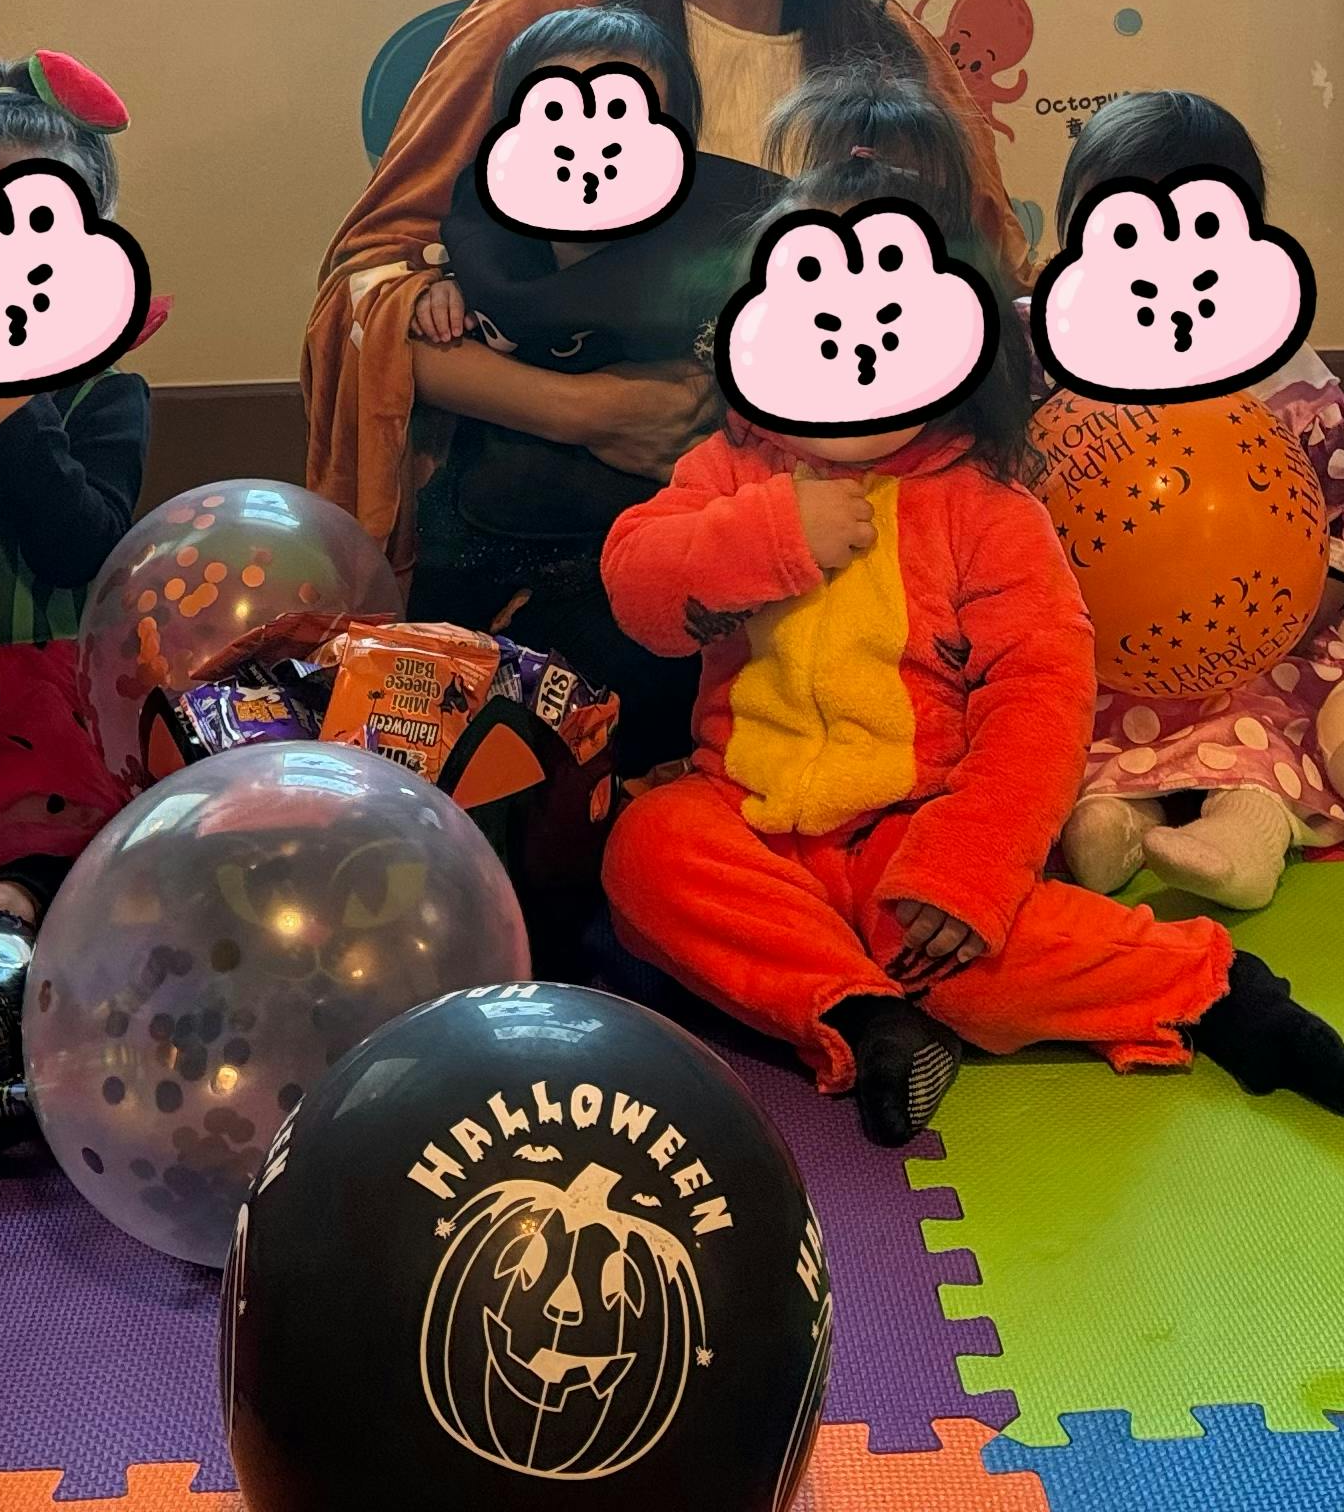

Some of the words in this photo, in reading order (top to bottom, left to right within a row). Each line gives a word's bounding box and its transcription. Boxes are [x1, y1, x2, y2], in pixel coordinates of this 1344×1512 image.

[1065, 116, 1084, 139] 章
[1058, 431, 1136, 501] HAPPY
[394, 657, 437, 682] Balls
[1144, 613, 1300, 695] HALLOWEEN
[1170, 635, 1248, 682] HAPPY
[385, 675, 442, 700] Cheese
[391, 695, 431, 717] Mini
[367, 714, 439, 747] Halloween
[407, 1080, 736, 1238] HALLOWEEN
